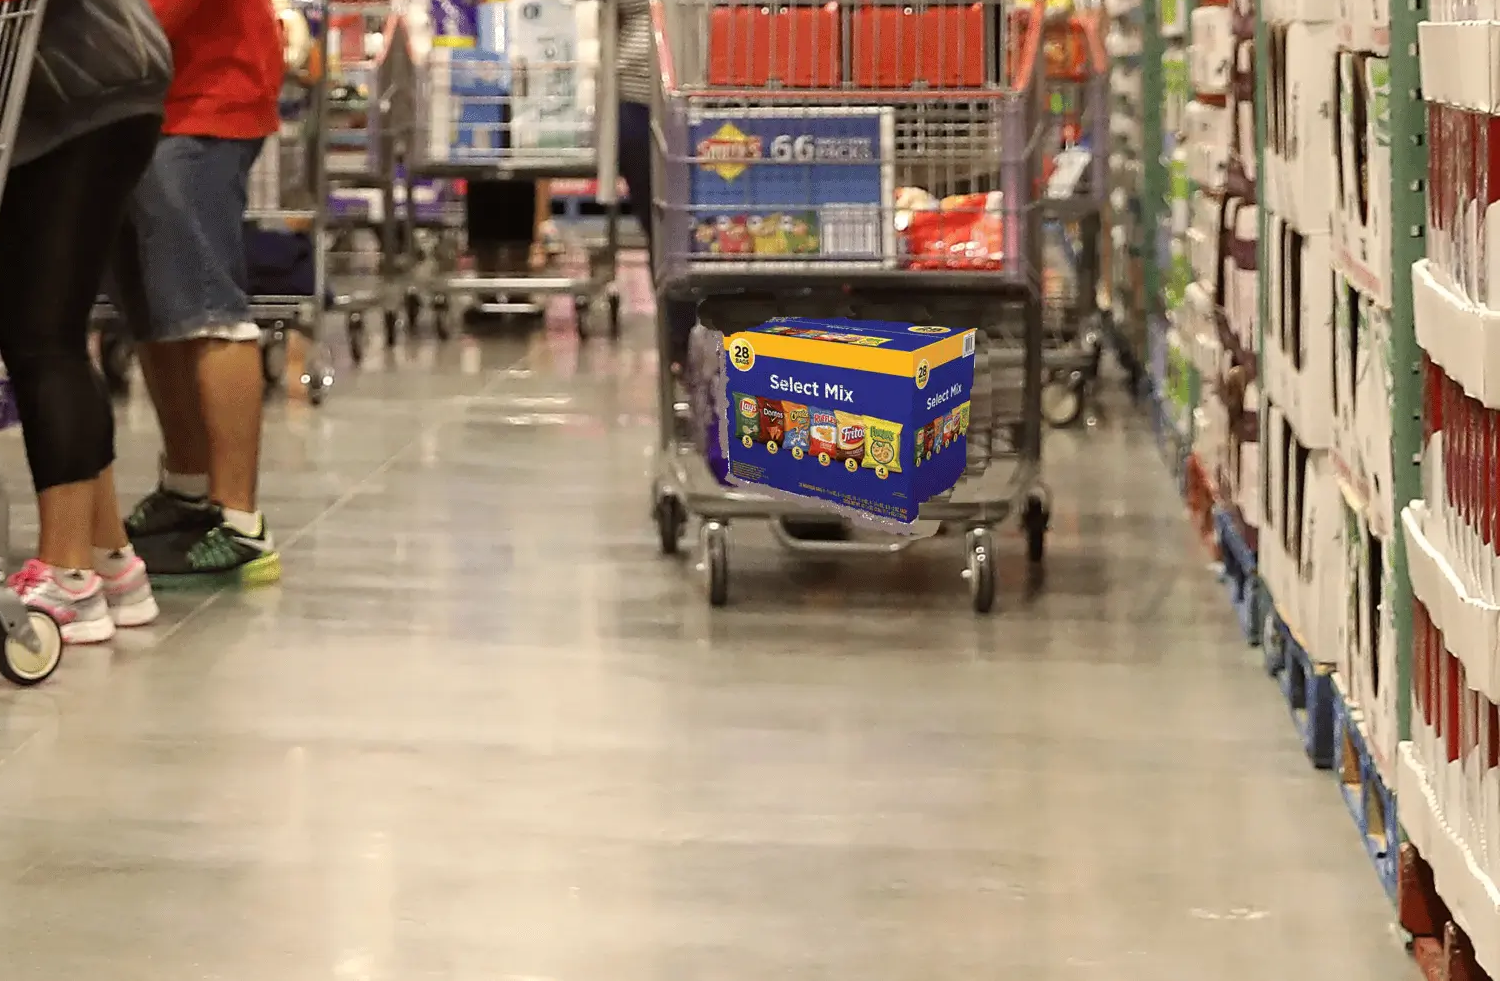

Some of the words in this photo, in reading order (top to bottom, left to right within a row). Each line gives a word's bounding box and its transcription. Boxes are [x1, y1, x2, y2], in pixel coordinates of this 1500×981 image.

[770, 134, 816, 162] 66
[734, 345, 750, 359] 28
[918, 365, 928, 379] 28
[769, 373, 819, 398] Select
[824, 382, 855, 404] Mix
[926, 387, 950, 411] Select
[950, 382, 963, 397] Mix
